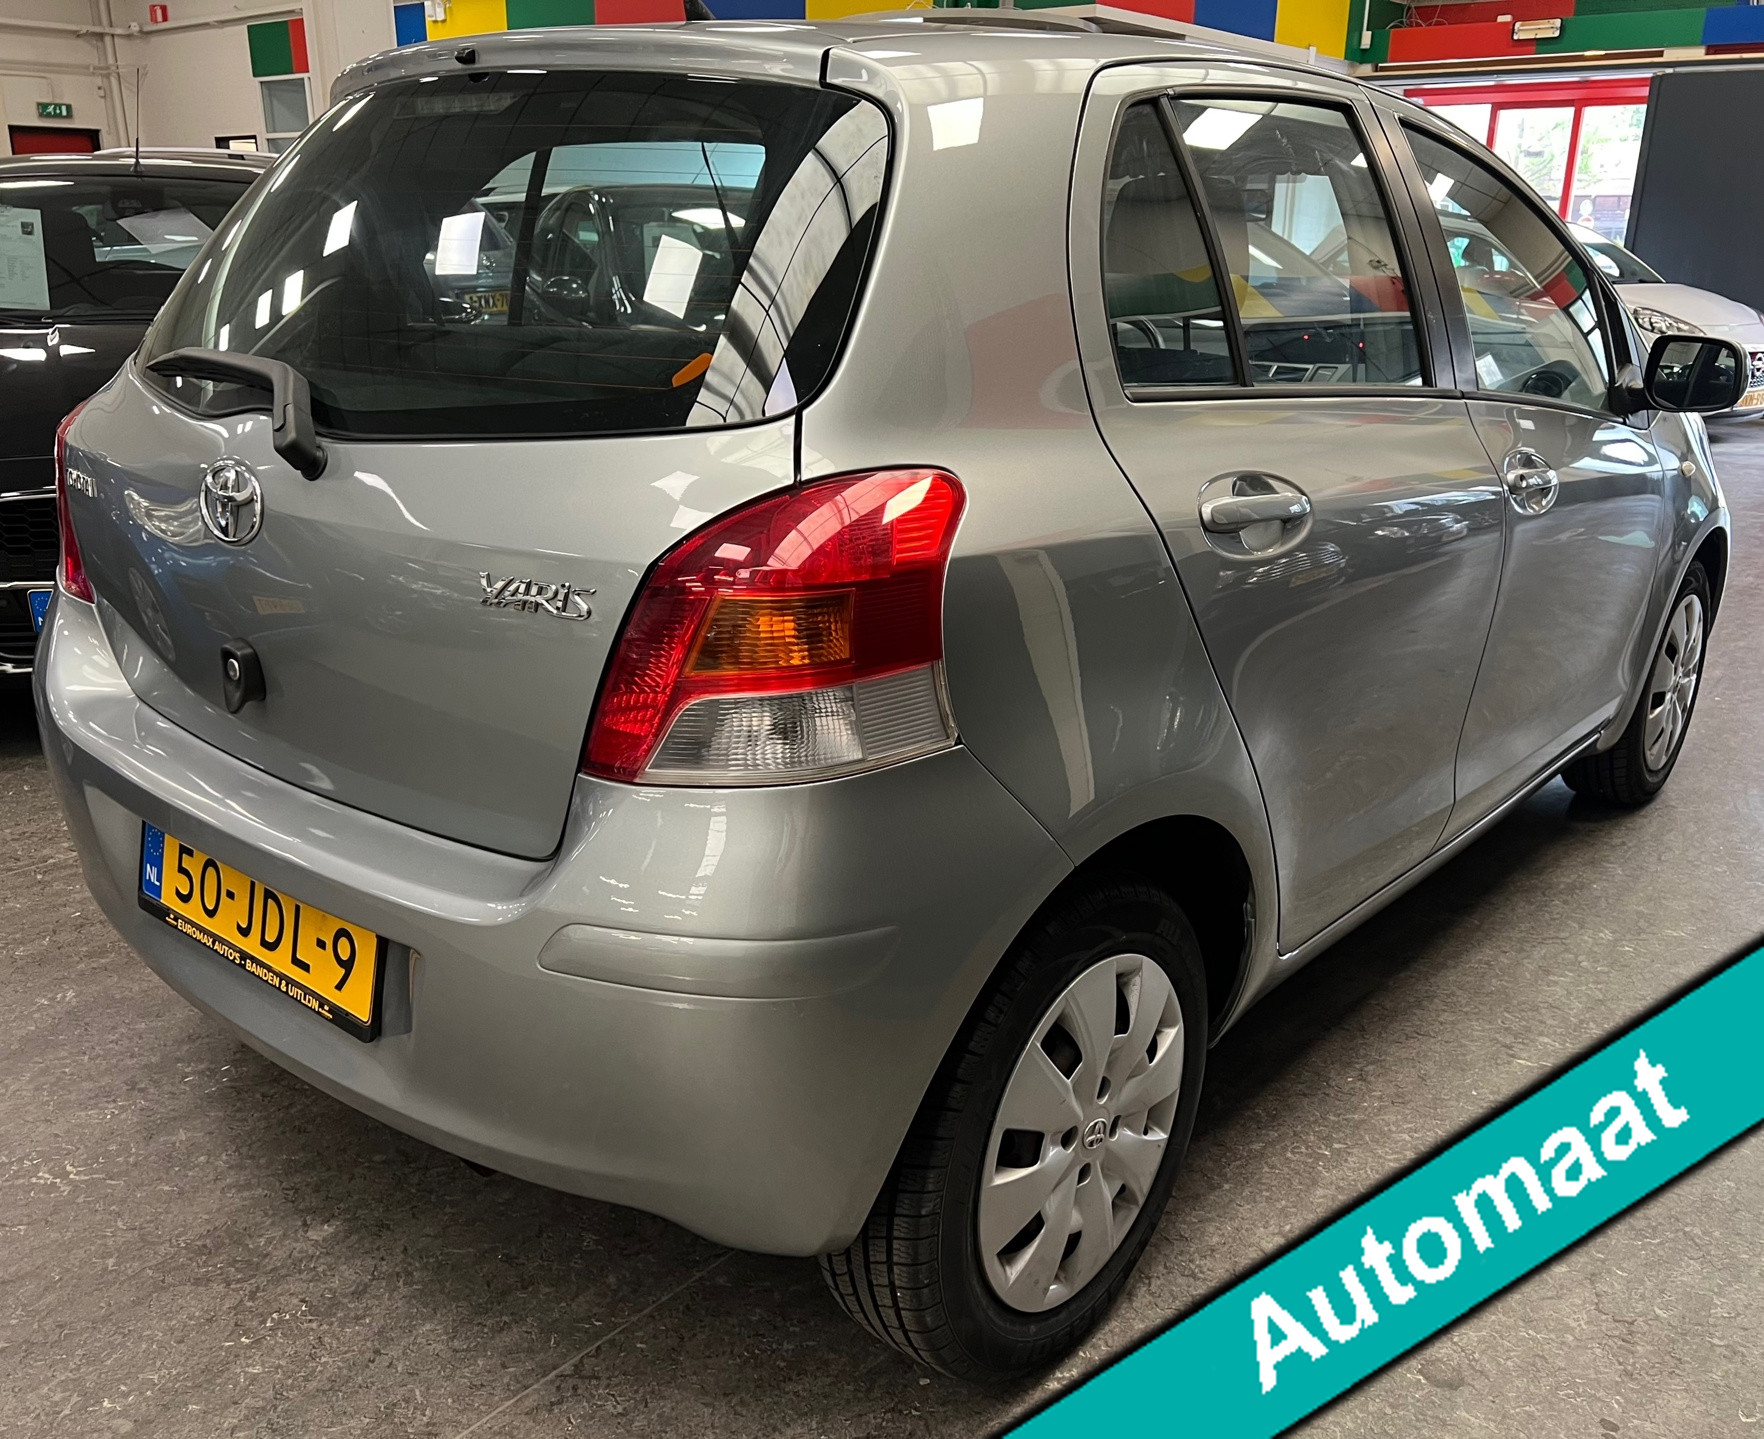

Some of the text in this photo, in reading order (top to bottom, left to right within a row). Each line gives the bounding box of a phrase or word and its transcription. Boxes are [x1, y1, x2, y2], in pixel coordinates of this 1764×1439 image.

[146, 863, 160, 886] NL
[174, 842, 357, 992] 50-JDL-9
[177, 918, 213, 950] EUROMAX
[213, 941, 241, 964] AUTO'S
[246, 958, 279, 988] BANDEN
[280, 979, 287, 991] &
[288, 983, 319, 1012] UITLIJN
